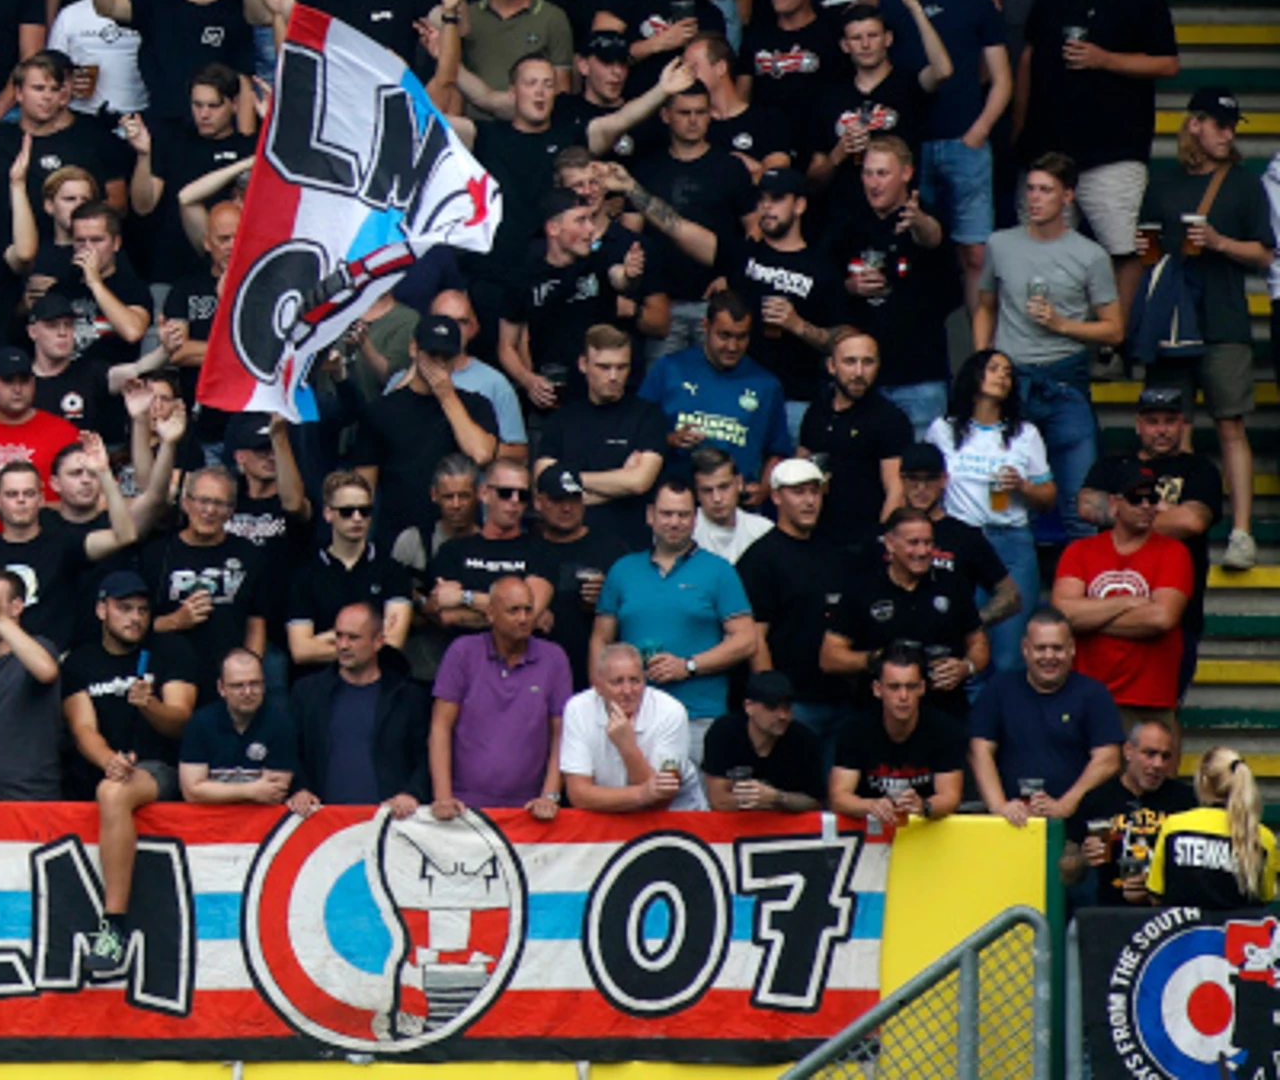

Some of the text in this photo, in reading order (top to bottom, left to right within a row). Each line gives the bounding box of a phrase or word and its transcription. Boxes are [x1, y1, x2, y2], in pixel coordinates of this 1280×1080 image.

[1131, 905, 1203, 950] SOUTH
[1109, 945, 1143, 987] THE
[1107, 992, 1137, 1056] FROM
